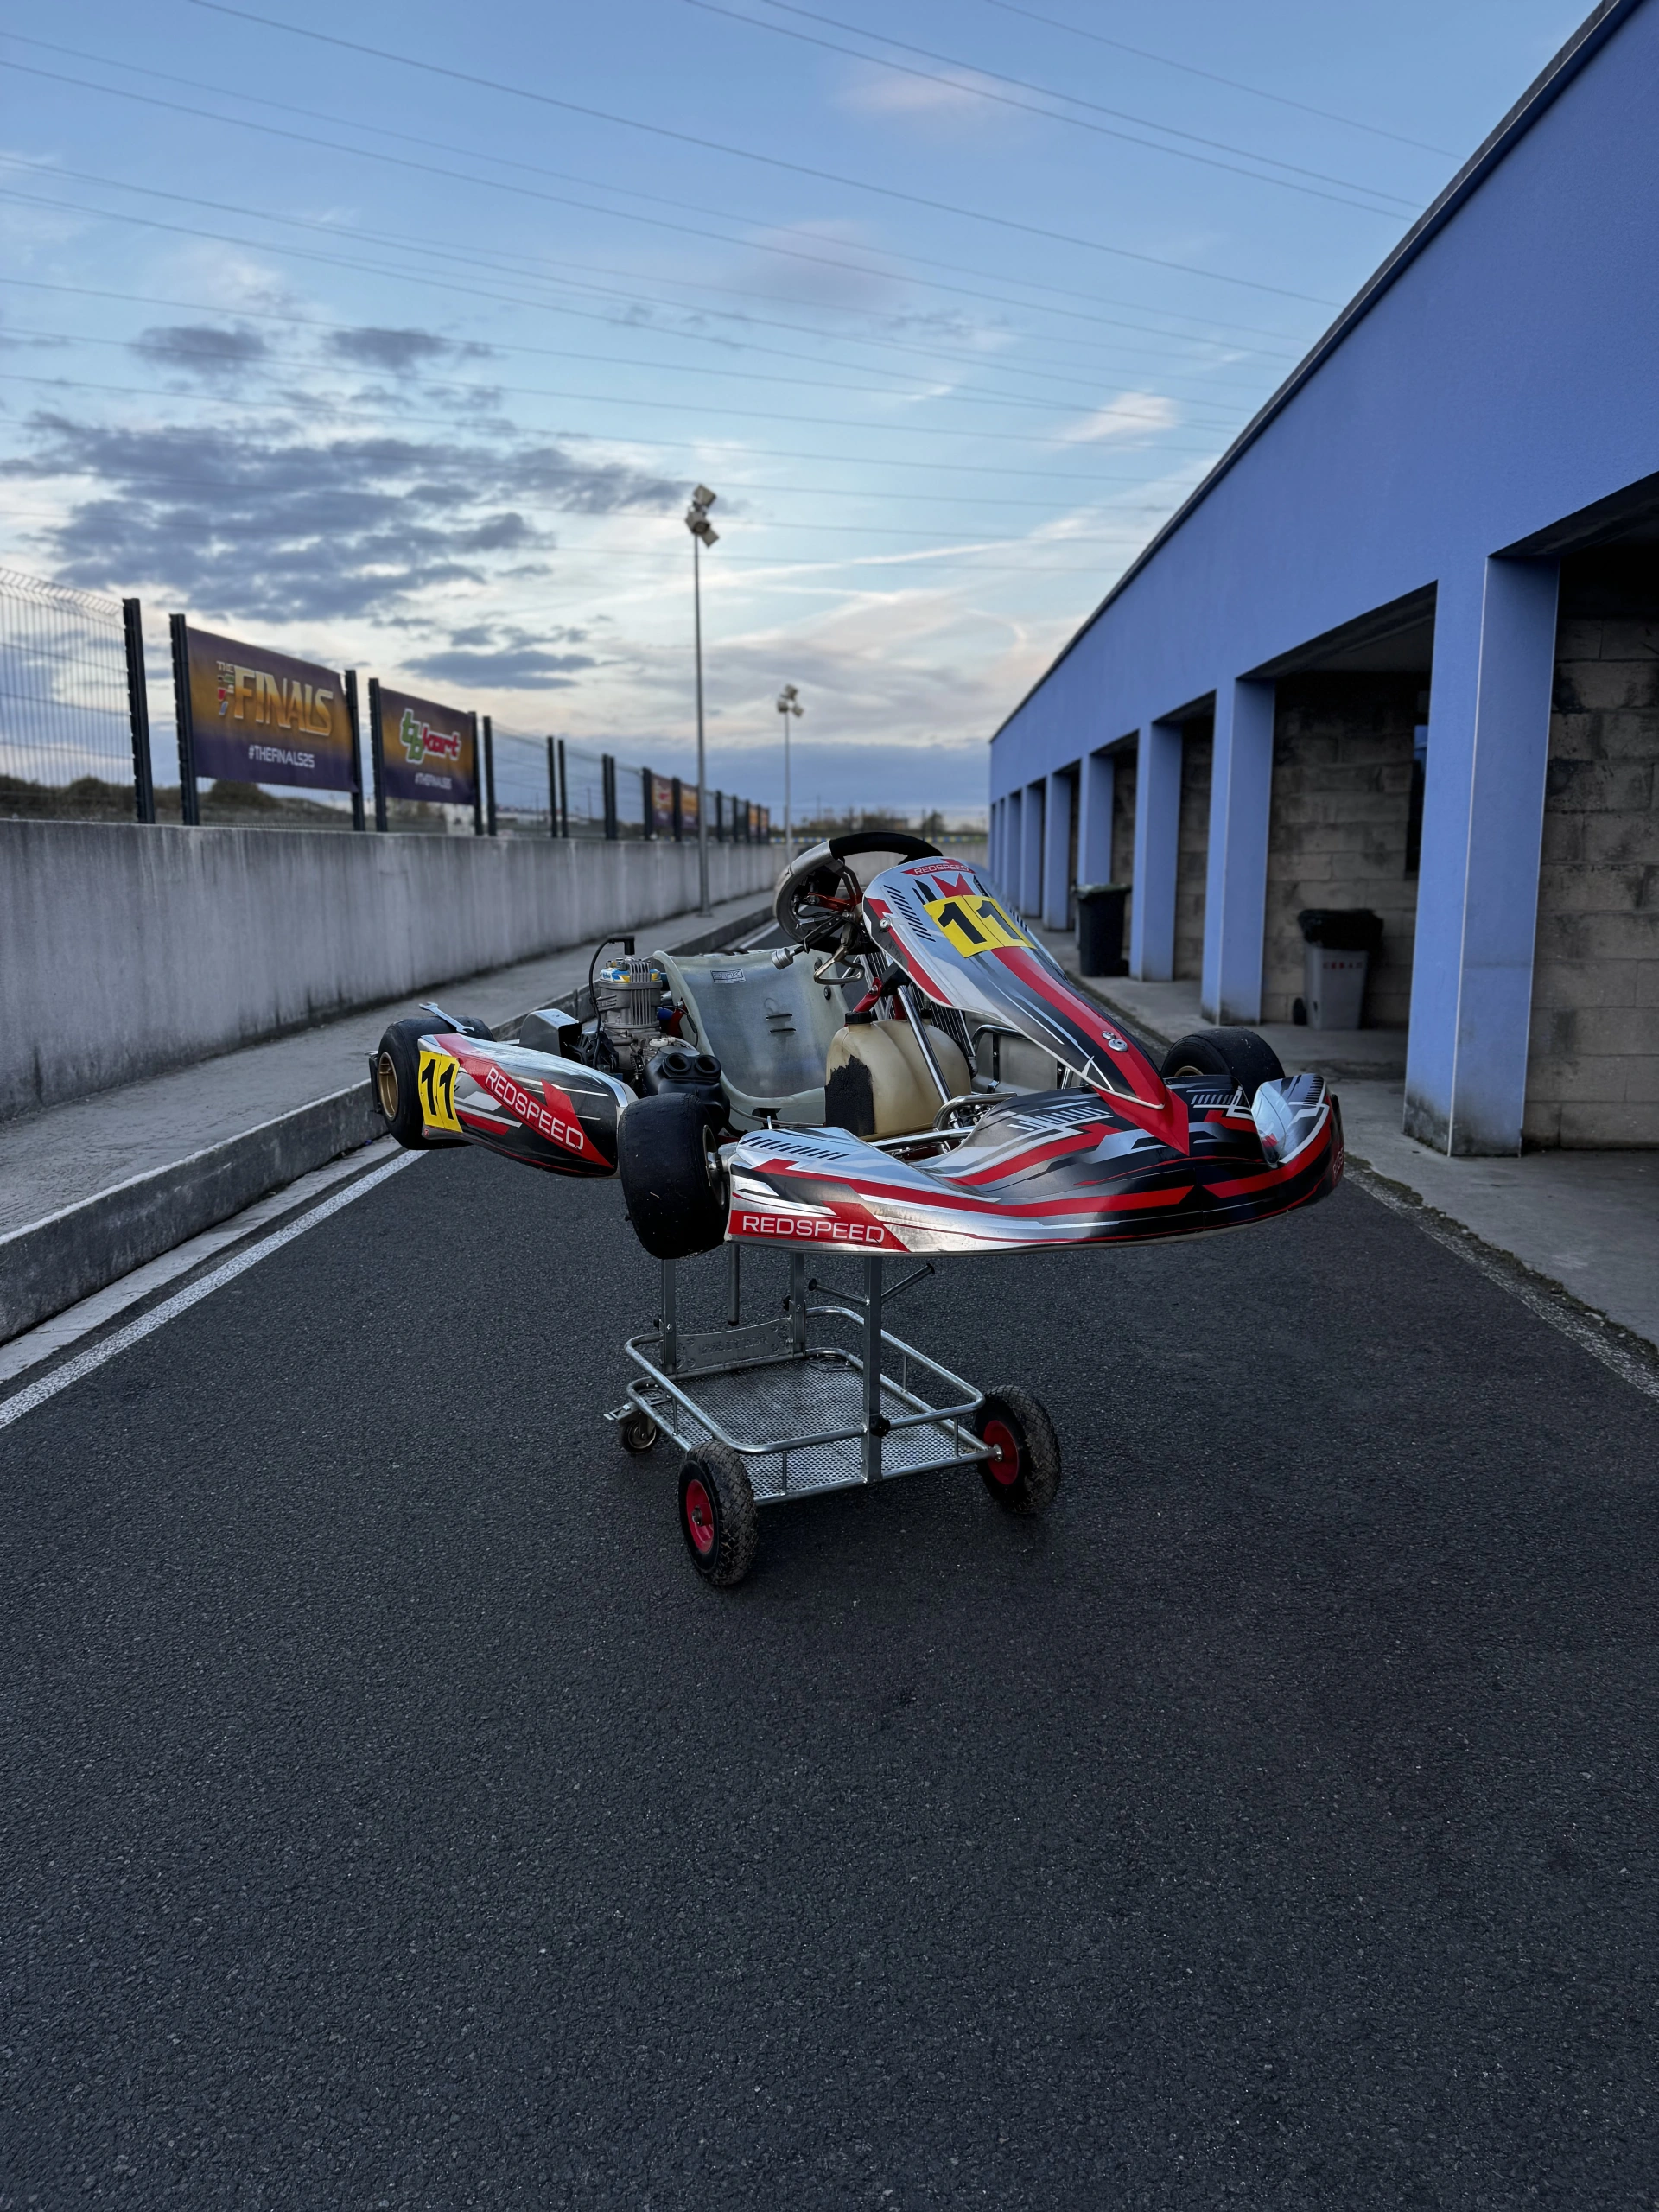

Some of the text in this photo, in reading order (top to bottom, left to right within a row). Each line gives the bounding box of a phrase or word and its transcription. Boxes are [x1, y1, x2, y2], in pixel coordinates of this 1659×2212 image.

[216, 660, 234, 673] THE
[234, 664, 334, 736] FINALS
[249, 744, 315, 768] #THEFINALS25
[914, 863, 969, 875] REDSPEED
[938, 900, 1023, 944] 11
[421, 1058, 455, 1121] 11
[485, 1066, 584, 1150] REDSPEED
[742, 1215, 885, 1243] REDSPEED
